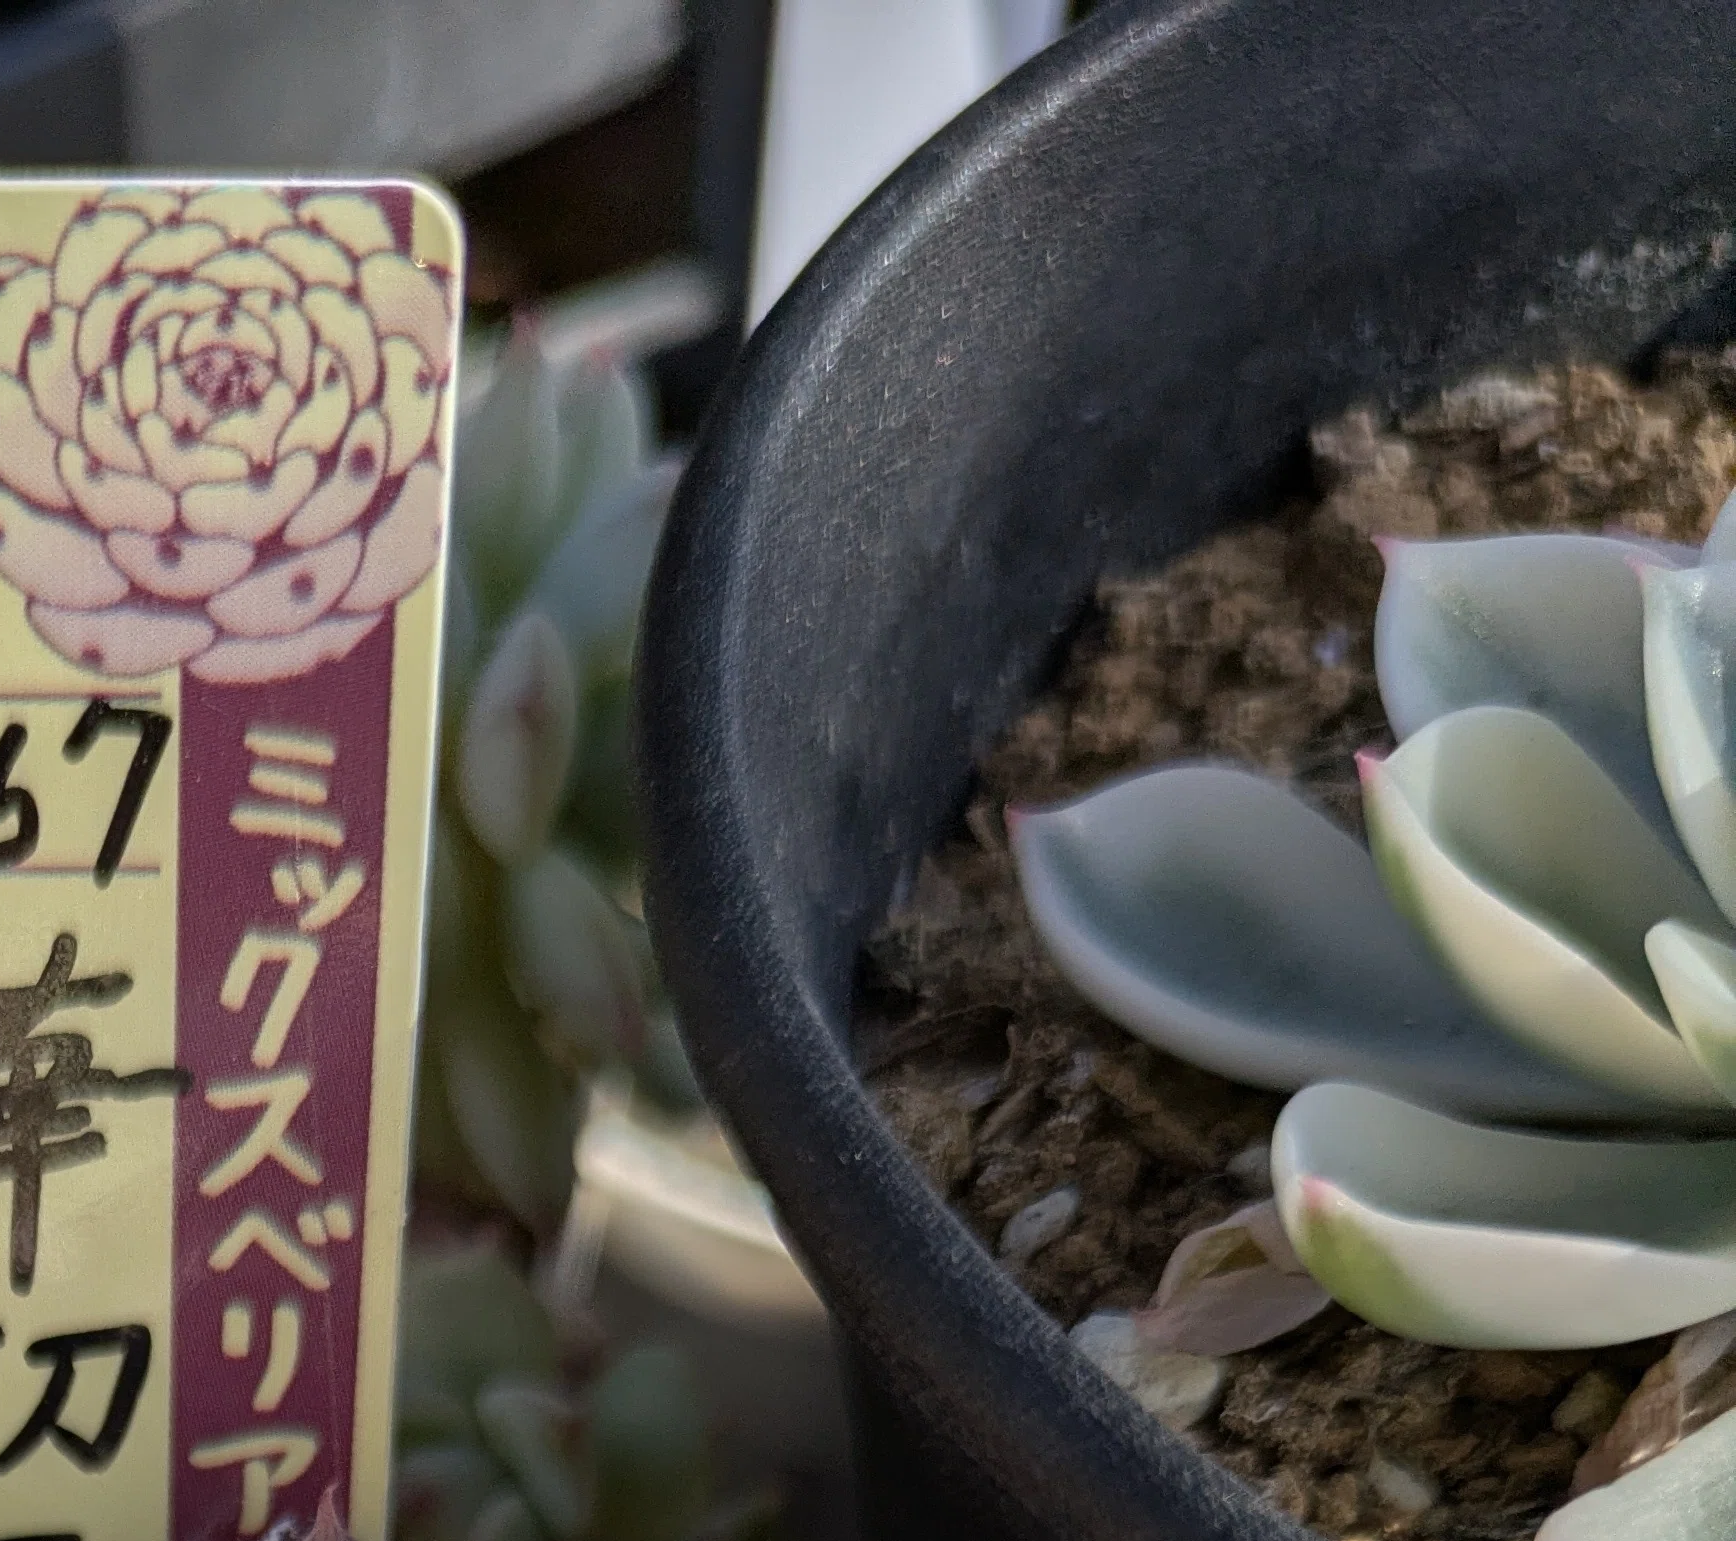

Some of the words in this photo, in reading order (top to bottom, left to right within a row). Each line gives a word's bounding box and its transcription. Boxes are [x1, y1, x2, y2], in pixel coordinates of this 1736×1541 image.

[189, 728, 368, 1536] ミックスベリア
